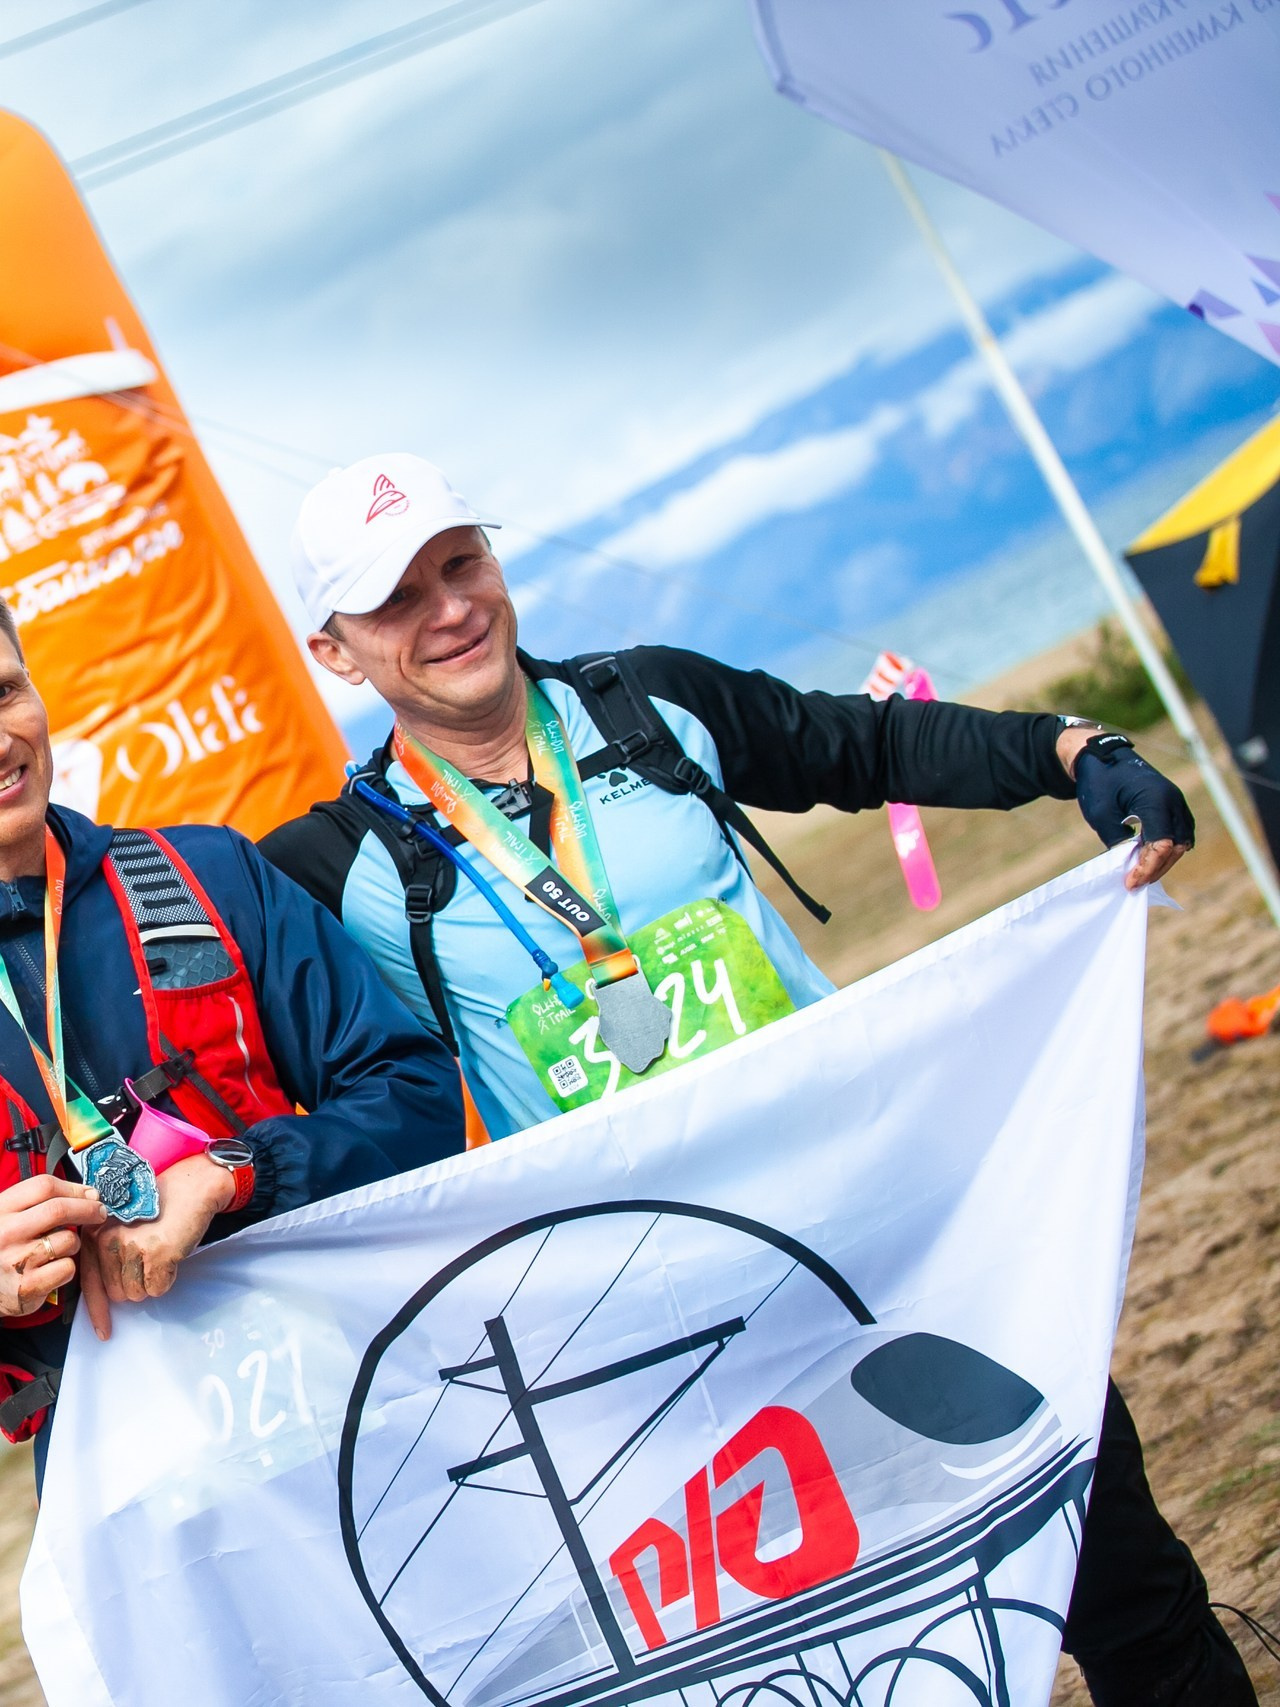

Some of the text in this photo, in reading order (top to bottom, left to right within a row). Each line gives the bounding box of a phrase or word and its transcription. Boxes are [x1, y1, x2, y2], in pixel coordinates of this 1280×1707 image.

[600, 777, 653, 805] KELME
[542, 880, 590, 922] OUT 50
